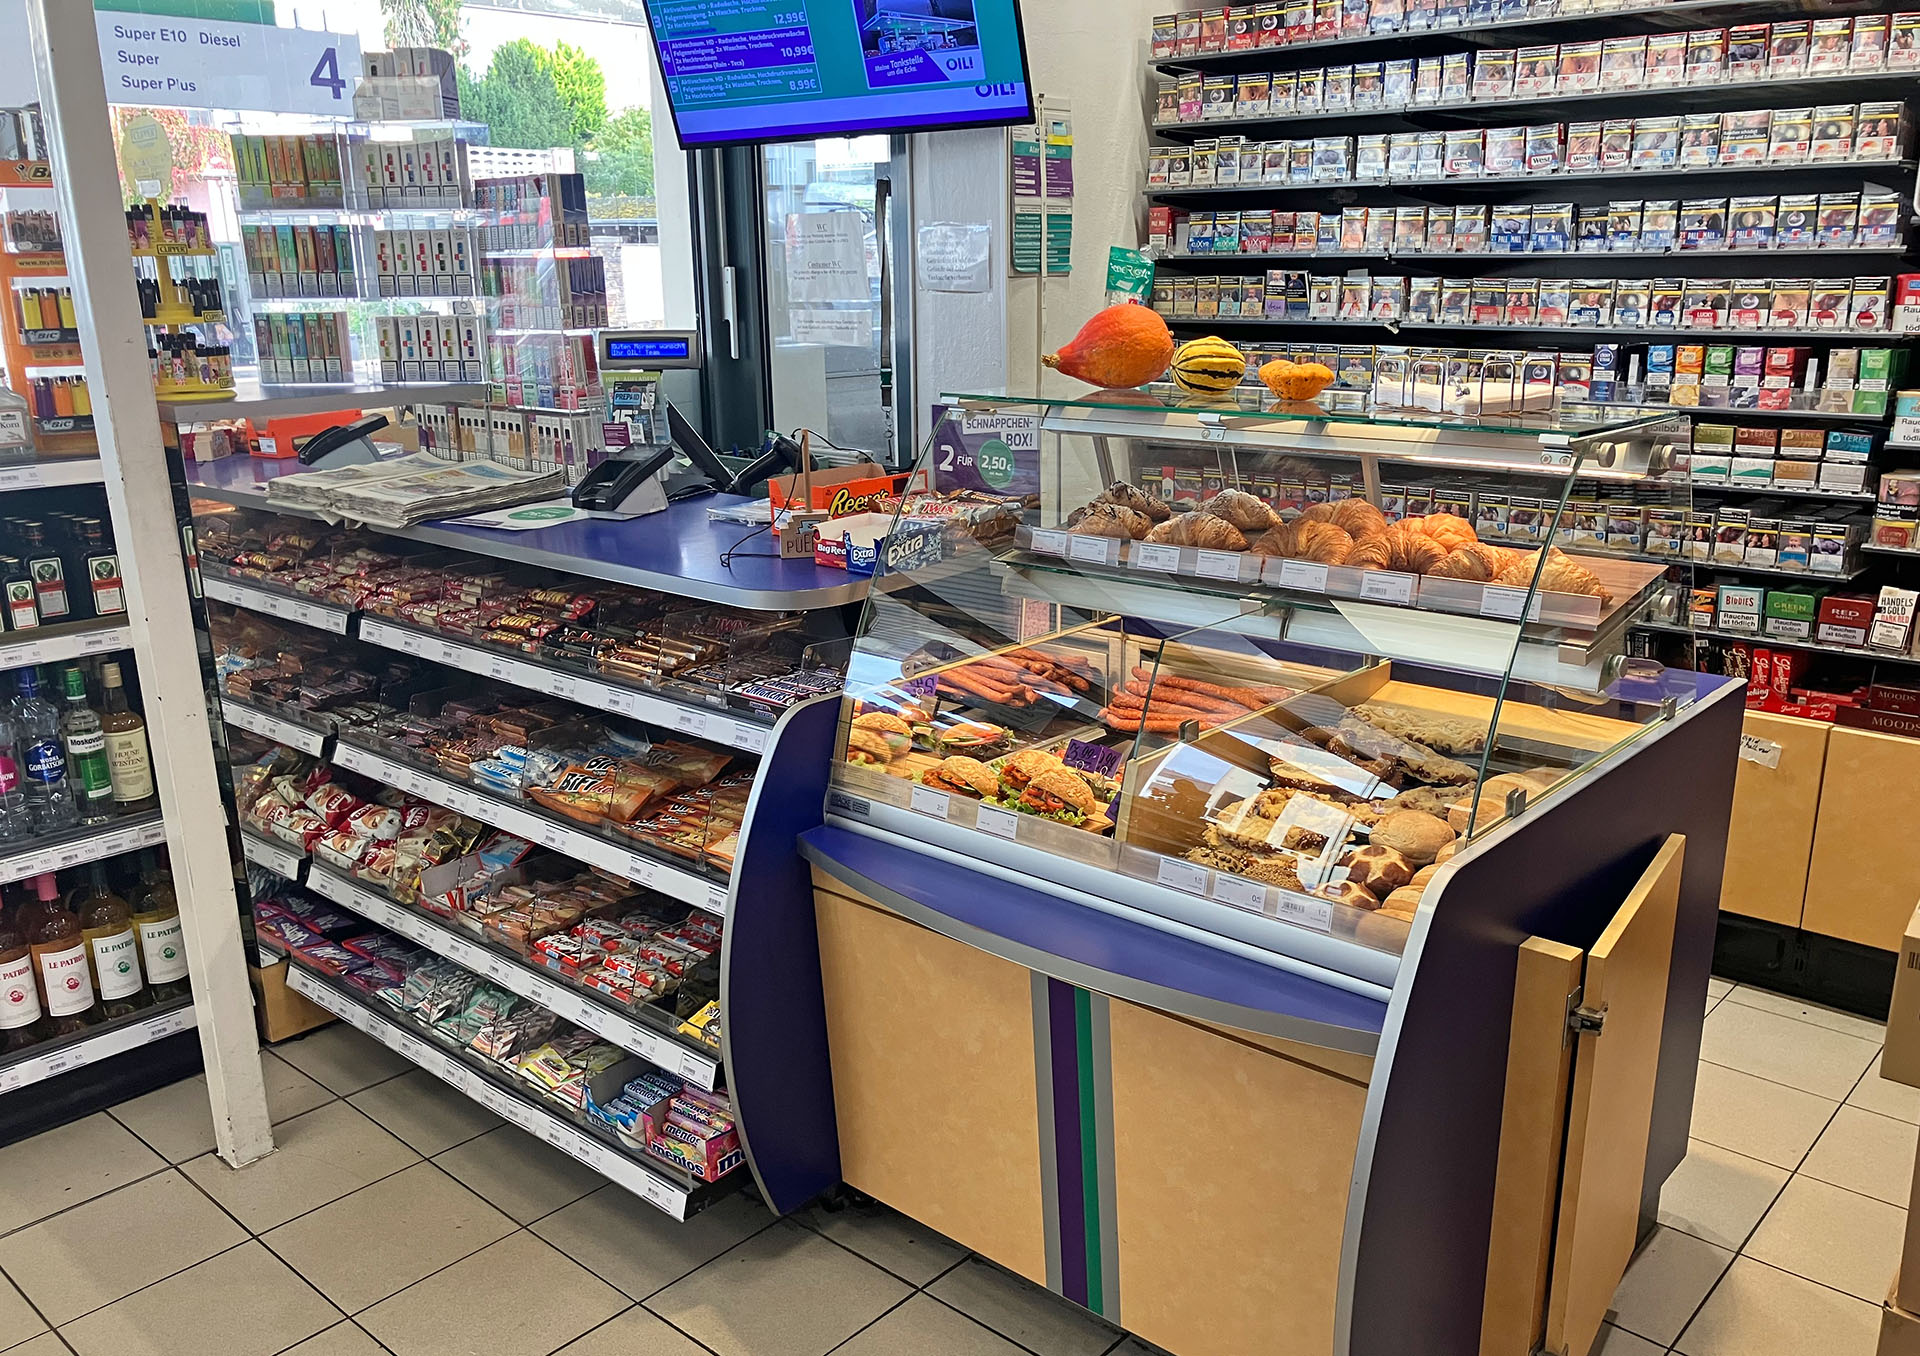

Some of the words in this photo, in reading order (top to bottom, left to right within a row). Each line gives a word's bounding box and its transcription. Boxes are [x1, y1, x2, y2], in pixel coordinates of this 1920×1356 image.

[773, 11, 806, 25] 12,99€
[113, 25, 156, 42] Super
[160, 28, 188, 43] E10
[199, 31, 241, 48] Diesel
[117, 50, 160, 66] Super
[661, 50, 672, 63] 4
[780, 45, 814, 58] 10,99€
[889, 55, 924, 69] Tankstelle
[945, 56, 974, 71] OIL!
[309, 47, 347, 100] 4
[121, 74, 164, 92] Super
[669, 81, 679, 93] 5
[789, 78, 817, 91] 8,99€
[974, 79, 1016, 98] OIL!
[158, 245, 186, 254] CLIPPER
[1005, 432, 1034, 448] BOX!
[1843, 434, 1870, 444] TEREA
[938, 444, 955, 473] 2
[956, 454, 974, 467] FÜR
[852, 547, 875, 560] Extra
[887, 533, 925, 569] Extra
[1880, 597, 1914, 608] HANDELS
[1722, 612, 1755, 621] Rauchen
[1831, 607, 1860, 618] RED
[1887, 606, 1906, 616] GOLD
[1720, 618, 1731, 626] ist
[1731, 618, 1756, 629] tödlich
[1878, 690, 1917, 702] MOODS
[1872, 715, 1920, 732] MOODS
[146, 931, 157, 940] LE
[100, 945, 110, 955] LE
[48, 961, 59, 970] LE
[59, 953, 86, 969] PATRON
[2, 965, 31, 981] PATRON
[645, 1074, 681, 1094] mentos
[627, 1083, 658, 1102] mentos
[651, 1142, 705, 1177] mentos
